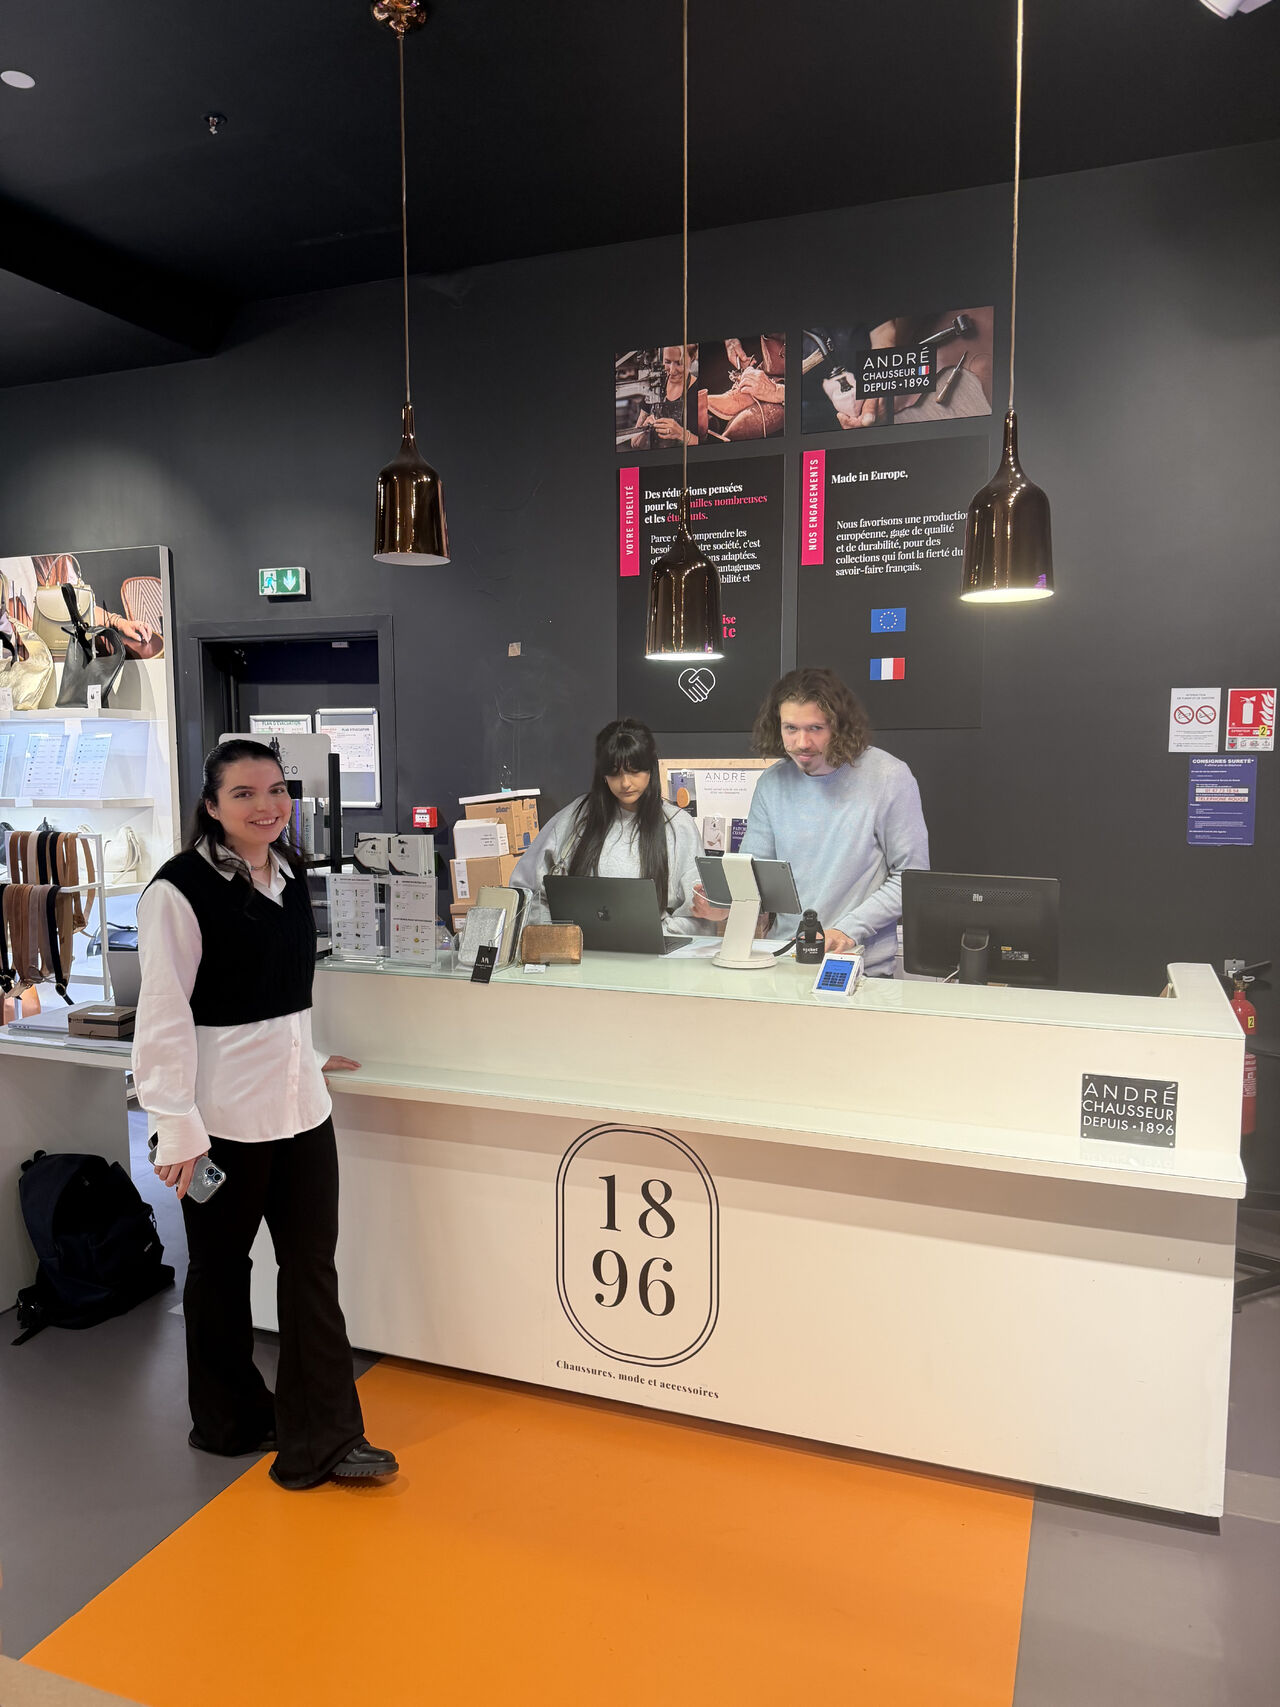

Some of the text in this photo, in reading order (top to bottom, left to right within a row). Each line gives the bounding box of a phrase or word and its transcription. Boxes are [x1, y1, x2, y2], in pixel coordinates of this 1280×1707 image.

[863, 347, 929, 370] ANDRÉ
[863, 368, 915, 381] CHAUSSEUR
[864, 381, 896, 392] DEPUIS
[831, 470, 908, 484] Made in Europe,
[645, 482, 743, 499] Des réduions pensées
[645, 504, 665, 513] pour
[666, 501, 678, 510] les
[714, 496, 768, 506] nombreuses
[808, 459, 818, 551] NOS ENGAGEMENTS
[645, 515, 652, 524] et
[654, 514, 665, 523] les
[836, 520, 858, 529] Nous
[860, 517, 903, 527] favorisons
[905, 516, 921, 524] une
[651, 535, 671, 543] Parce
[693, 530, 735, 540] omprendre
[736, 529, 747, 537] les
[836, 523, 954, 541] européenne, gage de qualité
[626, 528, 634, 555] VOTRE
[713, 540, 741, 550] société,
[743, 539, 760, 548] c'est
[836, 537, 941, 553] et de durabilité, pour des
[721, 551, 757, 562] adaptées.
[836, 547, 963, 564] collections qui font la fierté du
[836, 562, 921, 576] savoir-faire français.
[742, 574, 751, 582] et
[1260, 727, 1265, 735] 2
[1249, 1018, 1254, 1026] 2
[1084, 1082, 1176, 1106] ANDRÉ
[1083, 1100, 1173, 1121] CHAUSSEUR
[1084, 1116, 1128, 1131] DEPUIS
[556, 1360, 719, 1399] Chaussures, mode et accessoires
